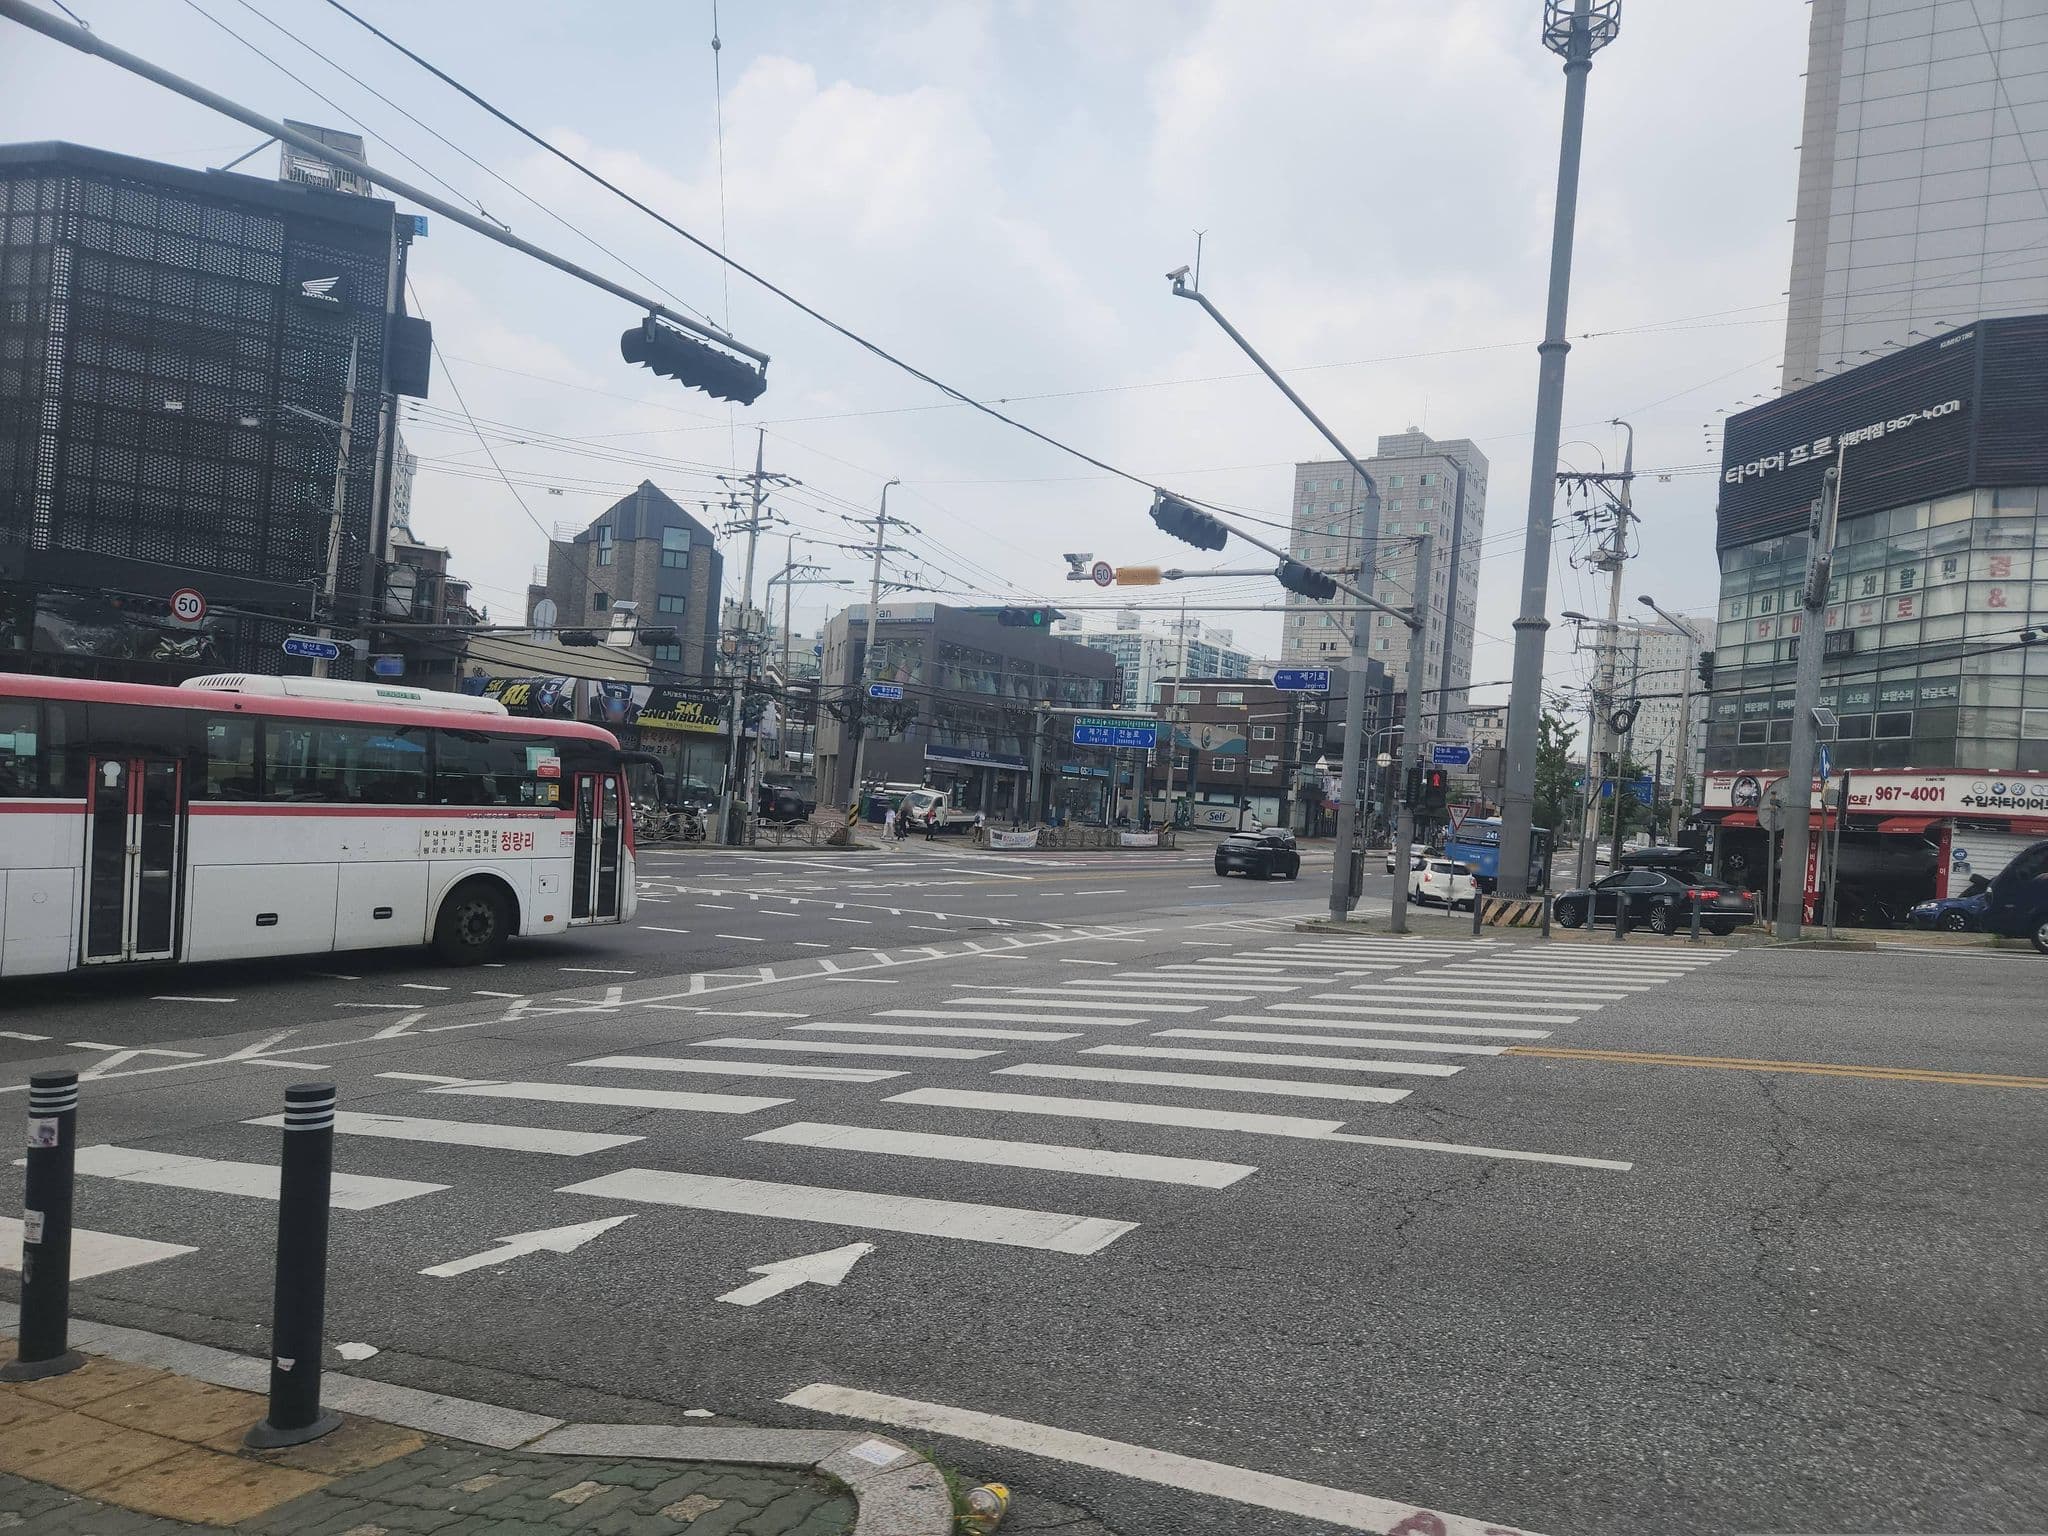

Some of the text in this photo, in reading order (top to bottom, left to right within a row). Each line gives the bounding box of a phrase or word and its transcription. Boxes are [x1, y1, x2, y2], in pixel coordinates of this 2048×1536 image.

[301, 291, 340, 303] HONDA
[1725, 450, 1785, 485] 타이어
[1787, 435, 1833, 467] 프로
[1886, 399, 1961, 434] 967-4001
[1096, 569, 1109, 580] 50
[178, 598, 198, 613] 50
[1299, 671, 1326, 681] 제기로
[488, 679, 507, 692] SKI
[500, 684, 531, 706] 80%
[675, 700, 704, 716] SKI
[640, 708, 722, 727] SNOWBOARD
[1088, 727, 1109, 736] 제기로
[1847, 786, 1946, 806] 으로! 967-4001
[1208, 811, 1227, 821] Self
[501, 831, 534, 852] 청량리
